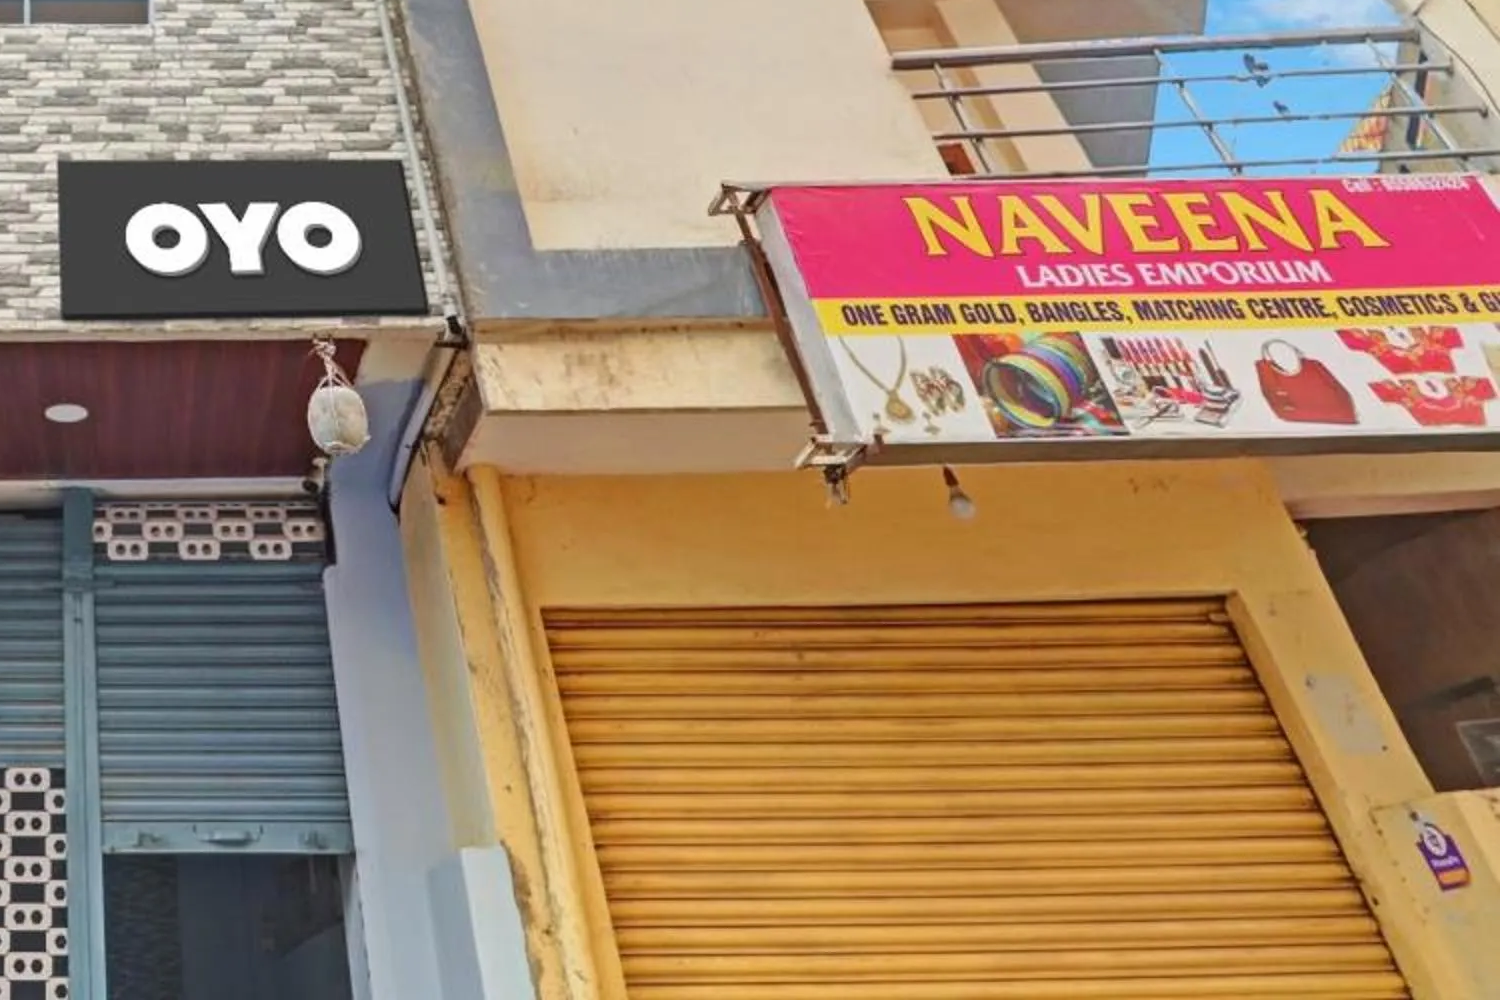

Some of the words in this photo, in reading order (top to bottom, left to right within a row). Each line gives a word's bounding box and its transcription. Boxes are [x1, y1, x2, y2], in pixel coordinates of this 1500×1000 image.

[125, 202, 362, 277] OYO
[902, 190, 1390, 256] NAVEENA
[1016, 263, 1133, 288] LADIES
[1138, 260, 1332, 286] EMPORIUM
[841, 304, 887, 326] ONE
[889, 303, 957, 325] GRAM
[959, 302, 1025, 326] GOLD,
[1028, 301, 1133, 324] BANGLES,
[1132, 299, 1246, 321] MATCHING
[1247, 297, 1339, 320] CENTRE,
[1337, 293, 1458, 316] COSMETICS
[1458, 292, 1480, 313] &
